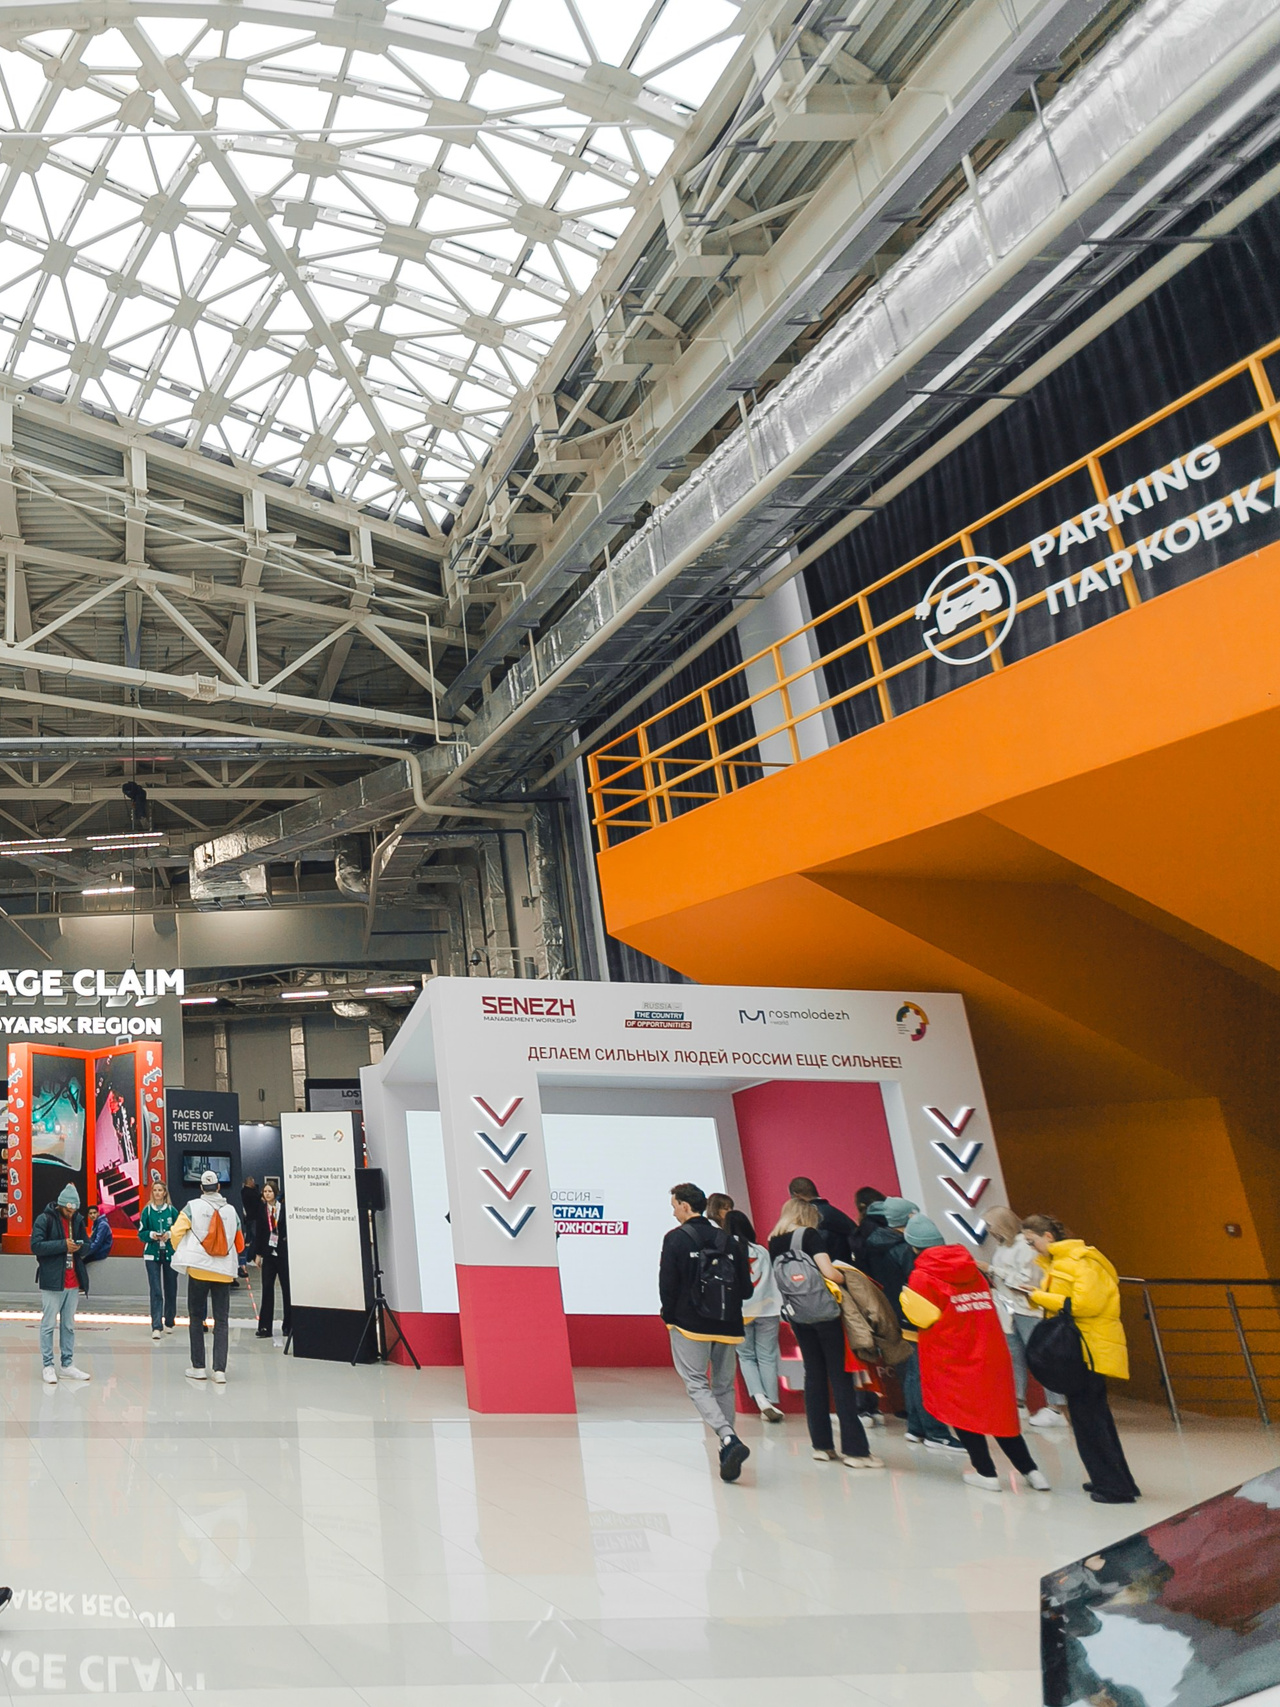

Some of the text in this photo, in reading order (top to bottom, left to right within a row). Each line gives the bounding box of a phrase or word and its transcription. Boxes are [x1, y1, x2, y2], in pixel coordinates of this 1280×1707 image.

[1030, 443, 1221, 568] PARKING
[73, 968, 185, 997] CLAIM
[481, 996, 576, 1017] SENEZH
[643, 1002, 672, 1010] RUSSIA
[636, 1011, 683, 1020] THE COUNTRY
[769, 1009, 850, 1021] rosmolodezh
[77, 1016, 162, 1035] REGION
[626, 1020, 691, 1029] OF OPPORTUNITIES
[527, 1046, 903, 1069] ДЕЛАЕМ СИЛЬНЫХ ЛЮДЕЙ РОССИИ ЕЩЕ СИЛЬНЕЕ!
[341, 1089, 361, 1098] LOS
[172, 1109, 214, 1120] FACES OF
[172, 1121, 234, 1132] THE FESTIVAL:
[173, 1133, 213, 1143] 1957/2024
[292, 1165, 311, 1173] Добро
[550, 1190, 591, 1202] ОССИЯ
[327, 1206, 350, 1215] baggage
[553, 1206, 600, 1218] СТРАНА
[295, 1213, 325, 1221] knowledge
